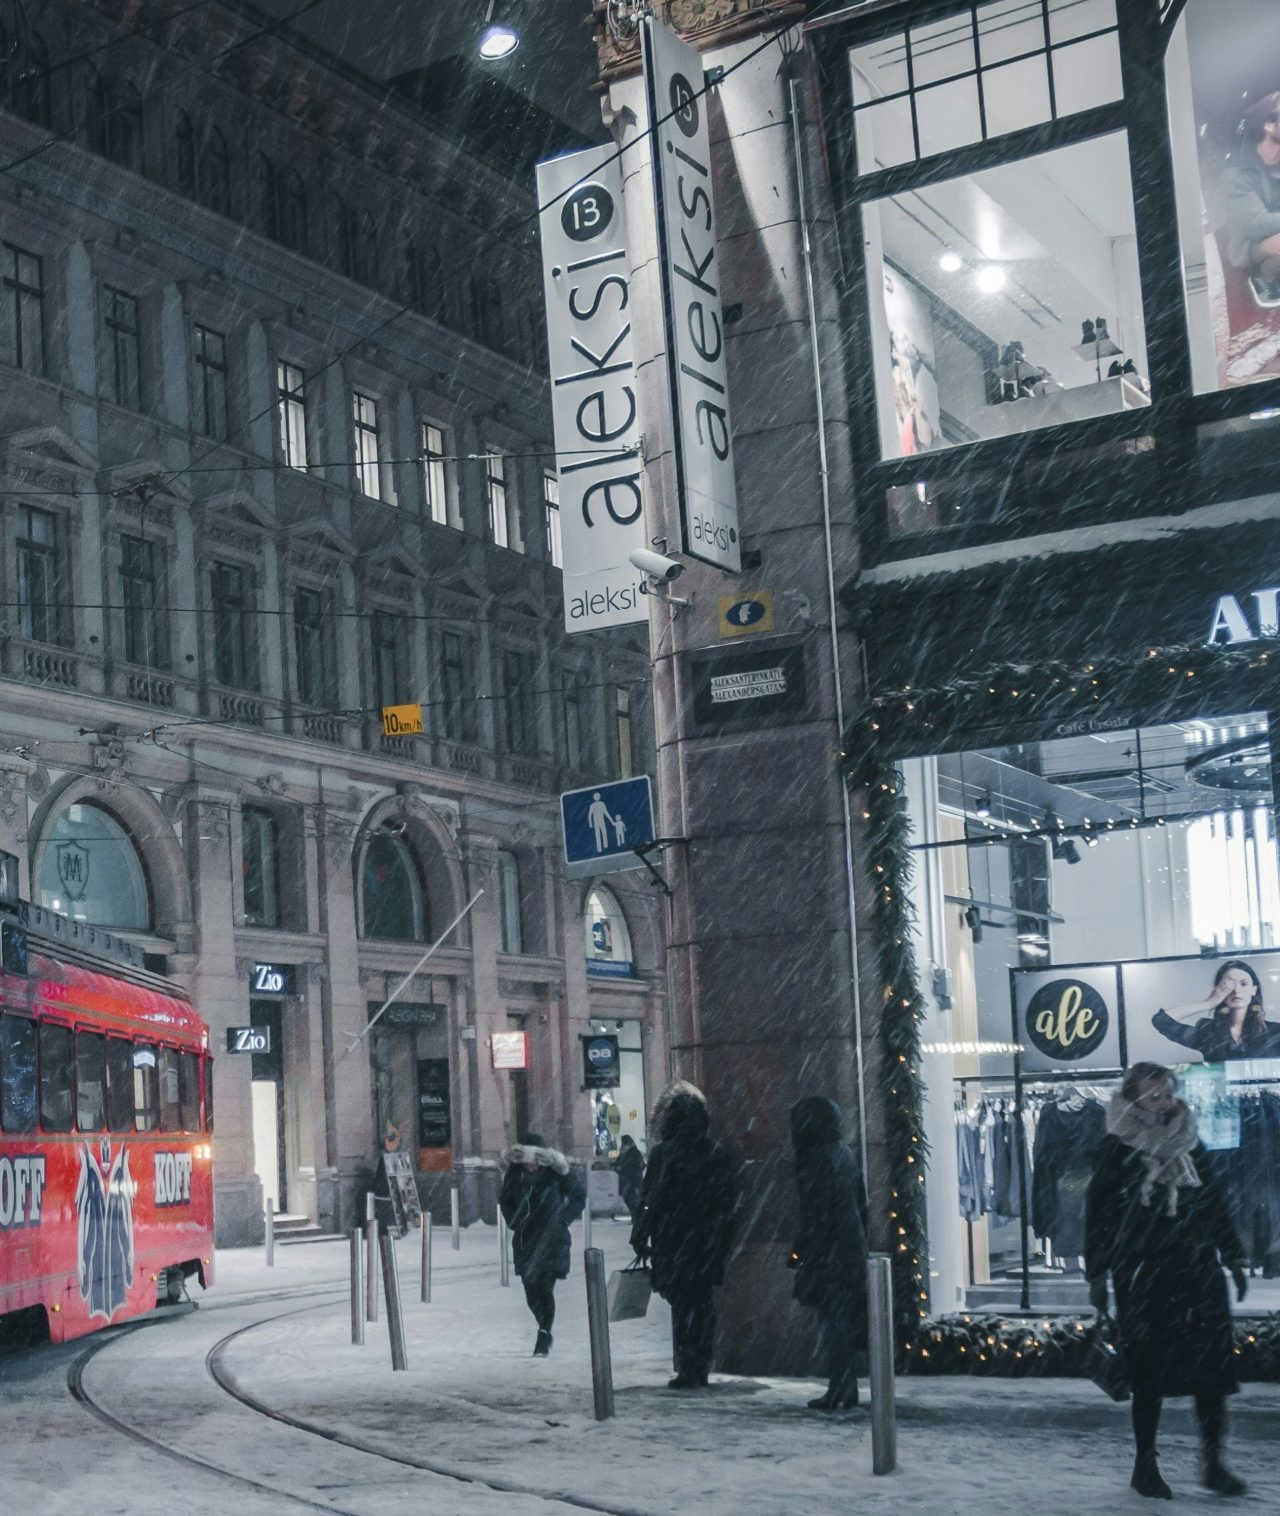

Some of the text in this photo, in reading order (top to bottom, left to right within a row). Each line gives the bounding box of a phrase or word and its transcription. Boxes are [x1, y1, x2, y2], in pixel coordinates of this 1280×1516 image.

[666, 140, 730, 462] aleksi
[552, 198, 644, 528] aleksi 13
[693, 512, 730, 554] aleksi
[570, 582, 637, 619] aleksi
[256, 965, 284, 991] Zio
[1035, 985, 1100, 1047] ale
[236, 1029, 266, 1051] Zio
[154, 1152, 193, 1204] KOFF
